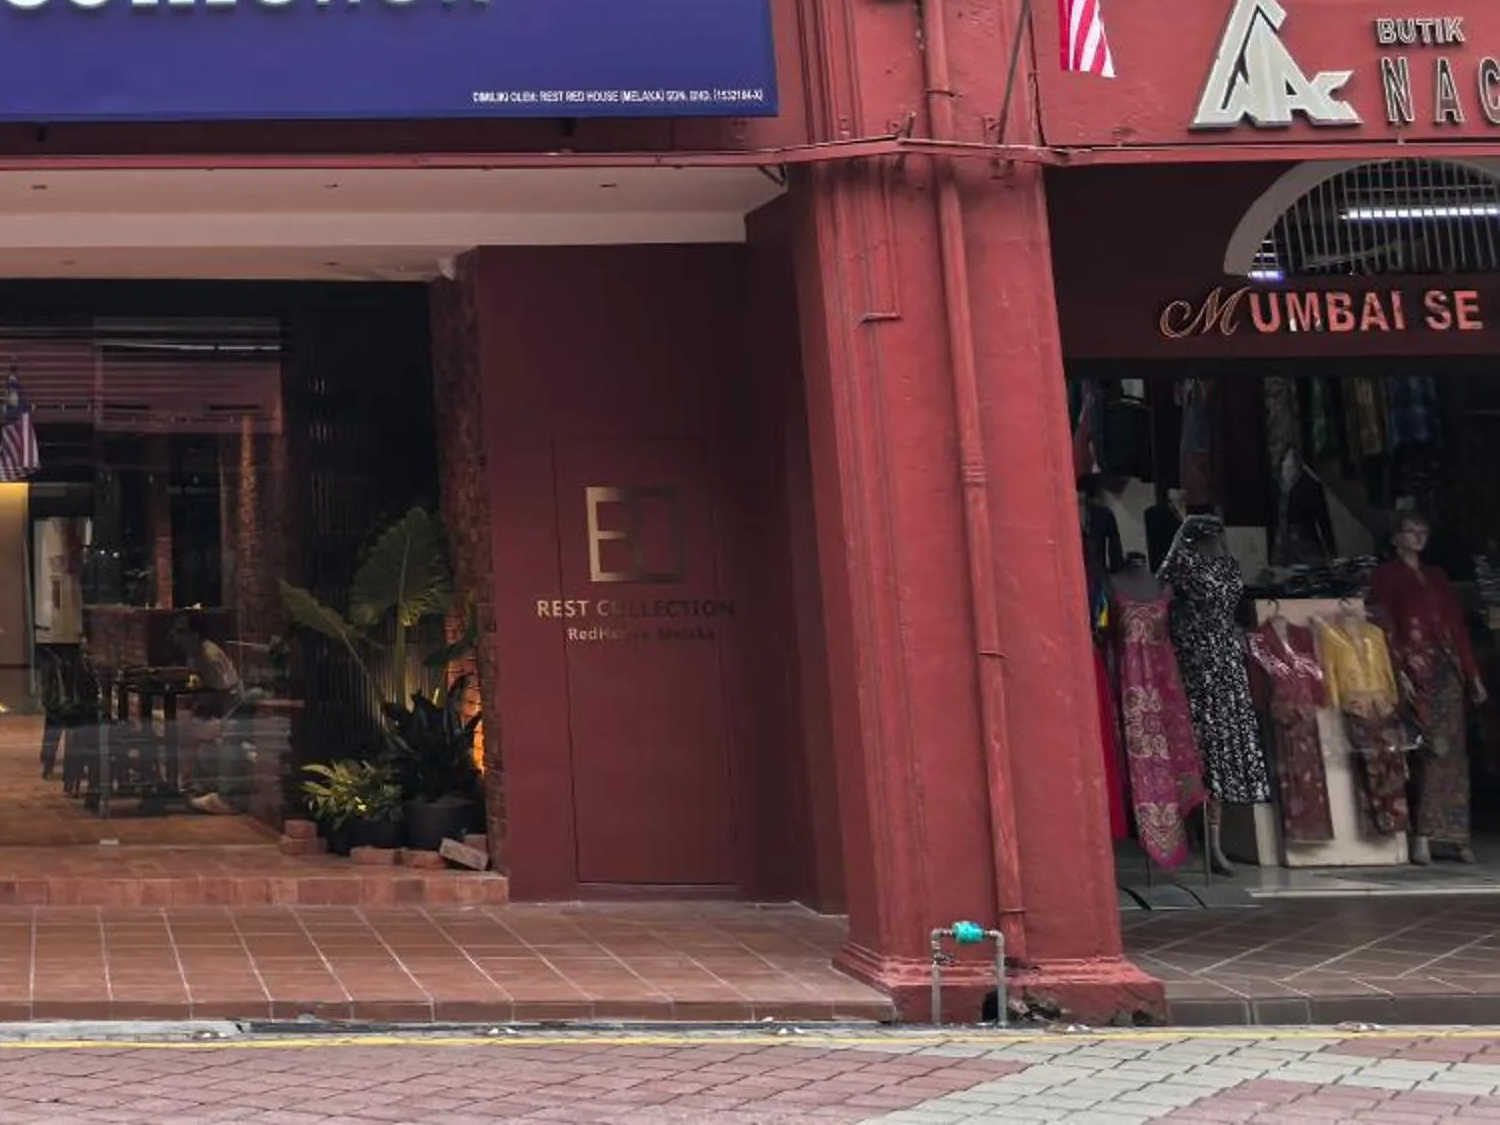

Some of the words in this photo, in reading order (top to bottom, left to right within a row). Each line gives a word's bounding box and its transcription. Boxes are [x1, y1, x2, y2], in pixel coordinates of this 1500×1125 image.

[1376, 17, 1466, 45] BUTIK
[539, 90, 564, 102] REST
[565, 90, 584, 102] RED
[586, 90, 619, 102] HOUSE
[1159, 286, 1404, 338] MUMBAI
[1424, 289, 1483, 331] SE
[536, 599, 590, 618] REST
